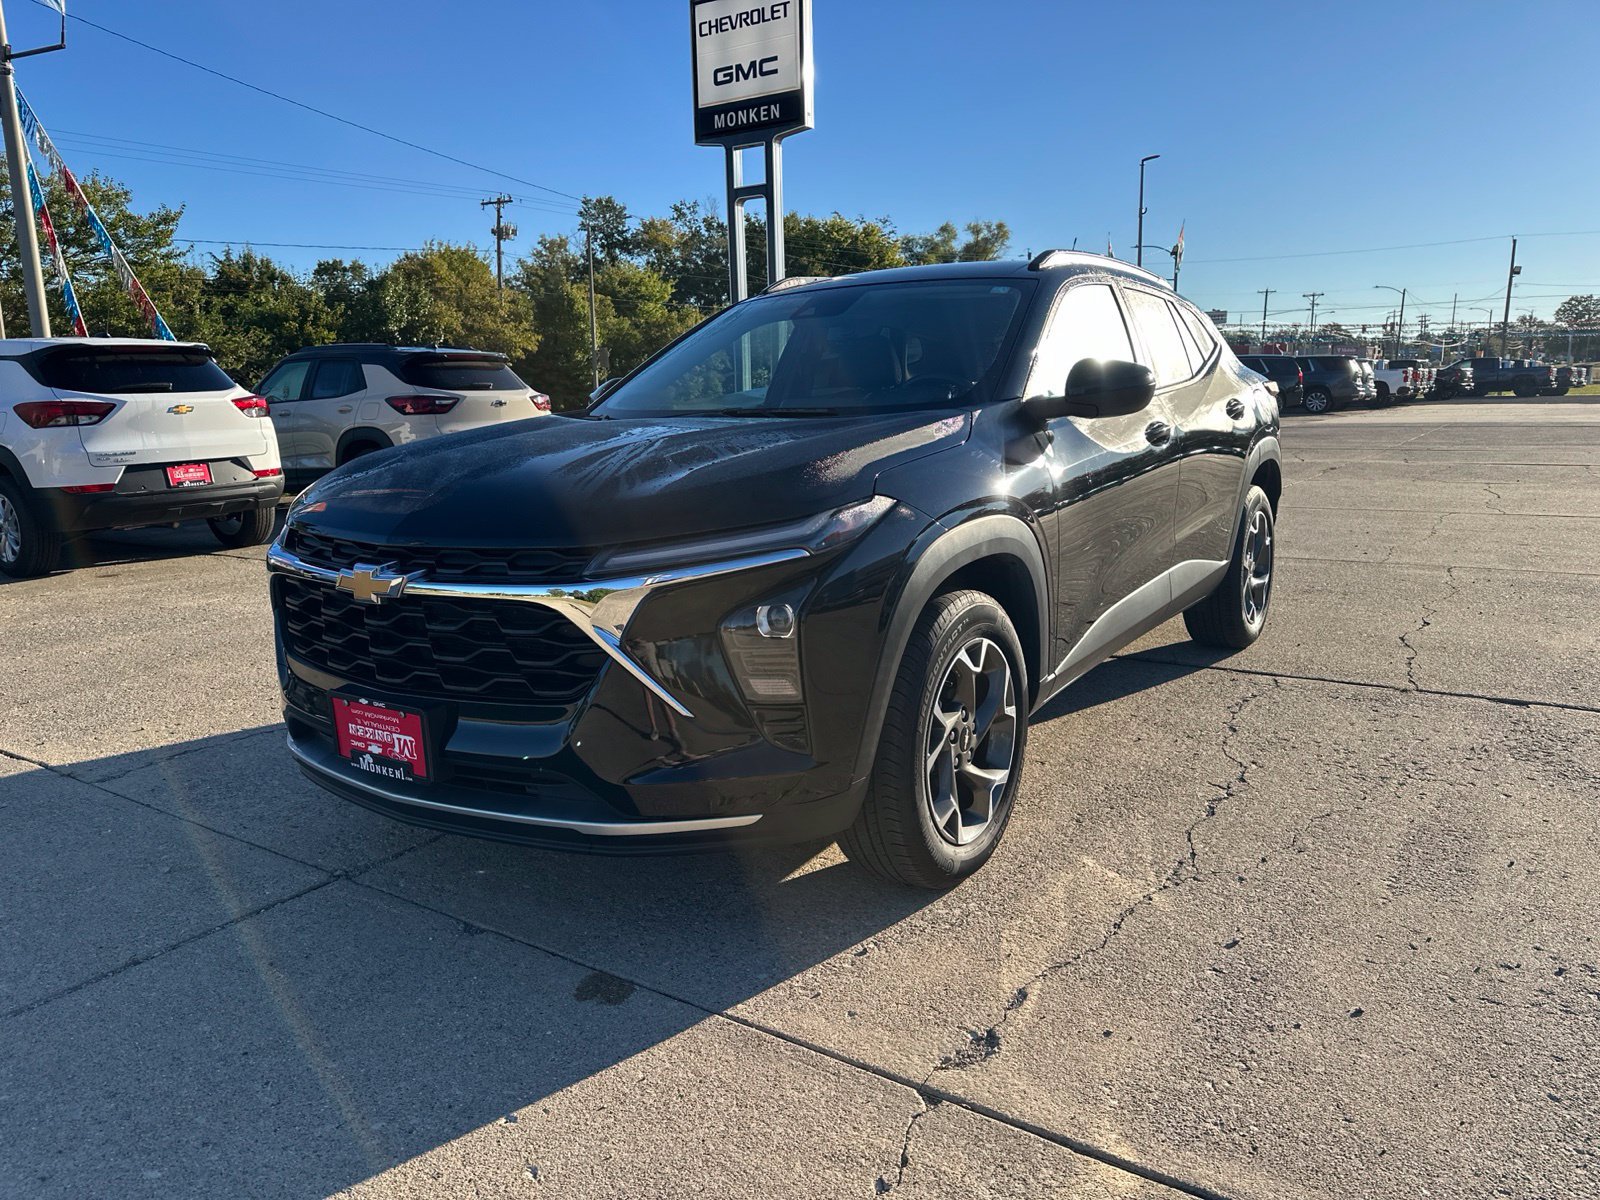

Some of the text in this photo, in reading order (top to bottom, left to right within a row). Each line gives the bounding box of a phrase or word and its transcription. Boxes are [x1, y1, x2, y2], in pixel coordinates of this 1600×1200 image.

[698, 1, 790, 38] CHEVROLET
[713, 55, 779, 87] GMC
[714, 103, 781, 129] MONKEN
